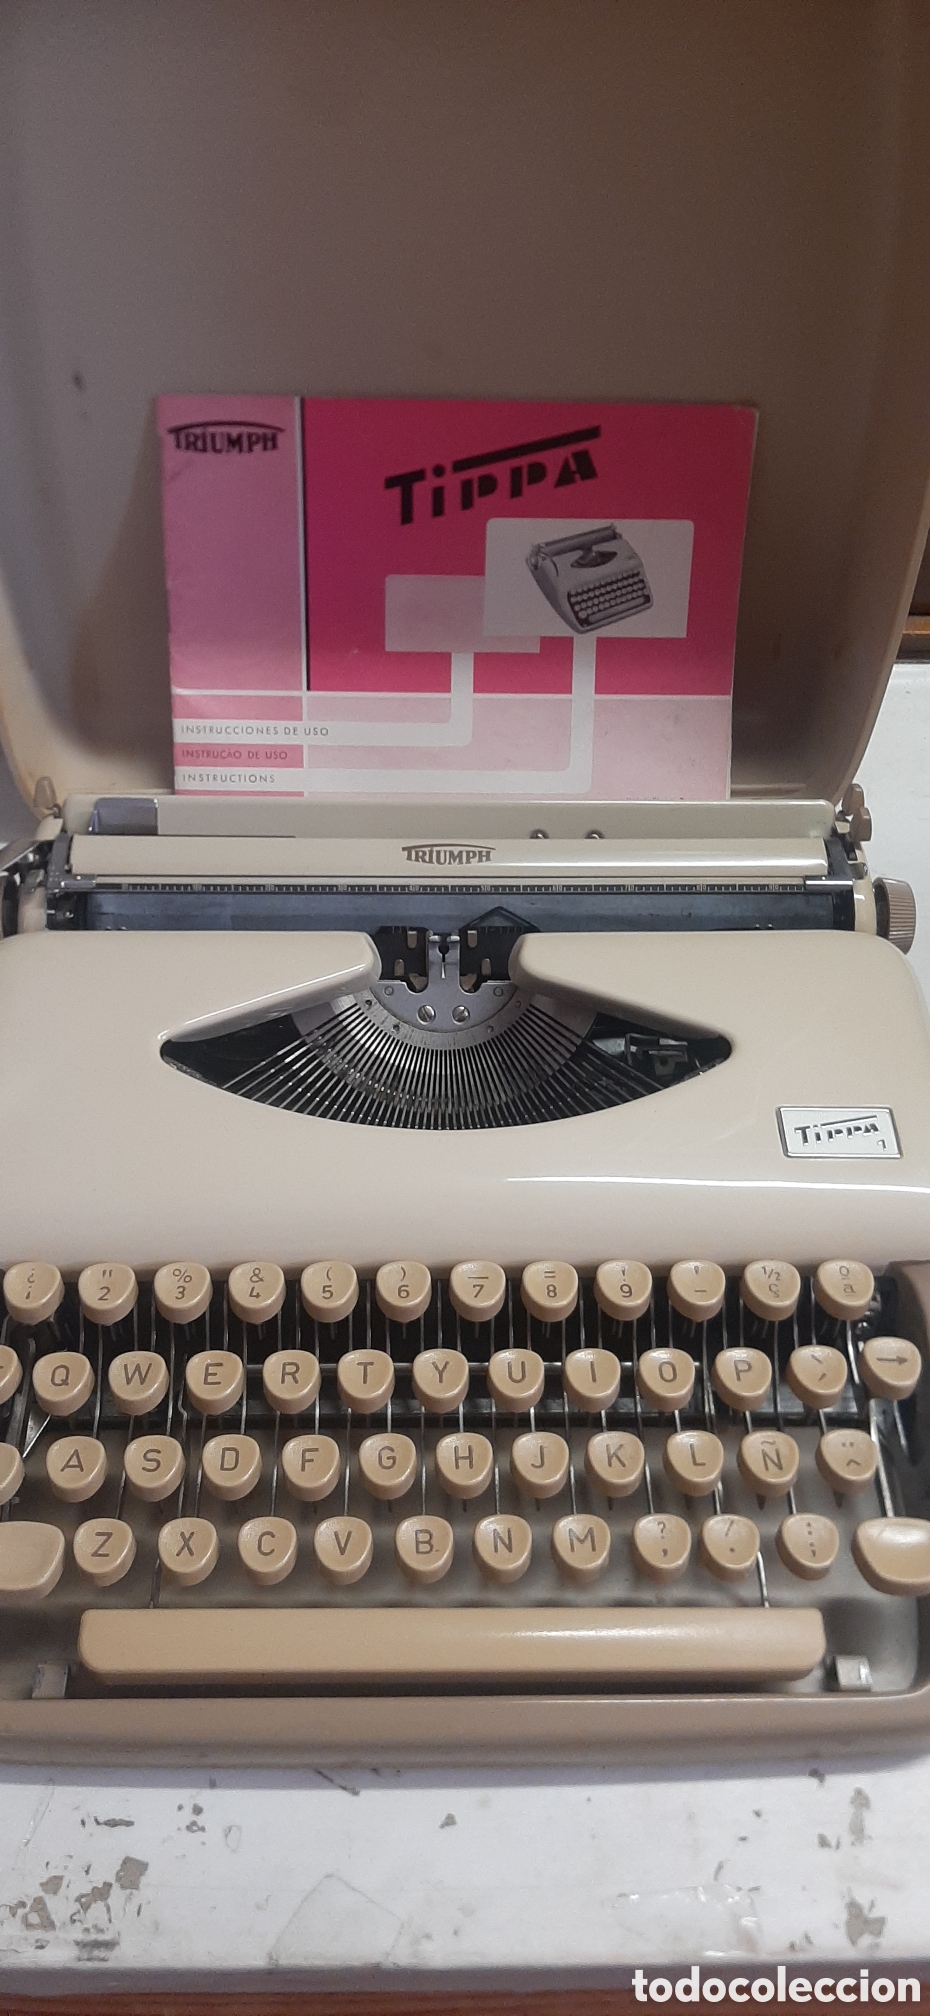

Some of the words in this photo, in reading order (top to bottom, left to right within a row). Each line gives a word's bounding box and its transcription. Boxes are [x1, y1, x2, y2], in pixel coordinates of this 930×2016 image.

[167, 421, 284, 453] TRIUMPH
[181, 725, 279, 736] INSTRUCCIONES
[283, 726, 299, 736] DE
[304, 727, 329, 736] USO
[247, 750, 260, 760] DE
[265, 750, 288, 760] USO
[182, 773, 276, 783] INSTRUCTIONS
[401, 843, 496, 865] TRIUMPH
[173, 1269, 192, 1283] %
[250, 1268, 264, 1283] &
[98, 1286, 110, 1300] 2
[176, 1286, 186, 1299] 3
[249, 1287, 261, 1298] 4
[323, 1285, 333, 1299] 5
[398, 1285, 410, 1298] 6
[473, 1284, 484, 1298] 7
[547, 1284, 557, 1298] 8
[620, 1284, 632, 1298] 9
[51, 1365, 69, 1386] Q
[124, 1363, 152, 1385] W
[204, 1363, 223, 1385] E
[281, 1362, 300, 1384] R
[357, 1362, 374, 1384] T
[432, 1361, 449, 1383] Y
[508, 1361, 526, 1383] U
[590, 1361, 596, 1383] I
[659, 1362, 677, 1383] O
[734, 1360, 752, 1382] P
[61, 1449, 84, 1472] A
[142, 1449, 161, 1472] S
[220, 1447, 239, 1471] D
[301, 1448, 319, 1472] F
[378, 1446, 396, 1470] G
[454, 1445, 473, 1469] H
[531, 1445, 545, 1469] J
[606, 1444, 626, 1468] K
[690, 1444, 706, 1466] L
[762, 1442, 783, 1471] Ñ
[91, 1532, 113, 1557] Z
[176, 1532, 194, 1557] X
[258, 1531, 275, 1556] C
[334, 1531, 352, 1555] V
[415, 1529, 434, 1554] B
[494, 1528, 512, 1553] N
[569, 1527, 596, 1552] M
